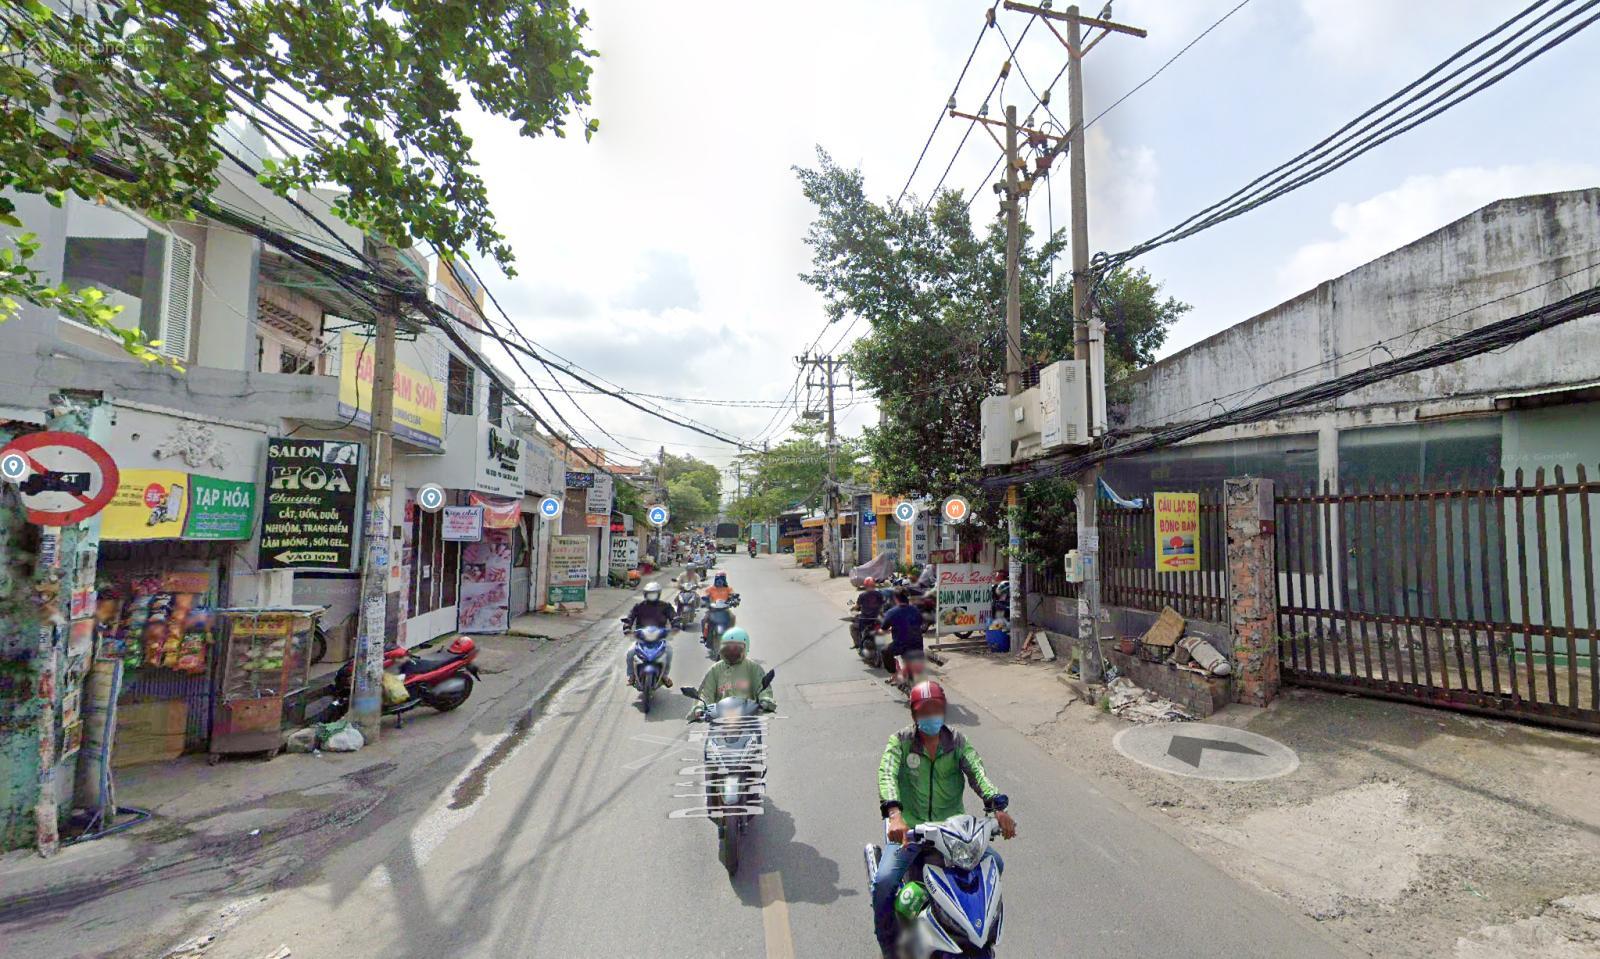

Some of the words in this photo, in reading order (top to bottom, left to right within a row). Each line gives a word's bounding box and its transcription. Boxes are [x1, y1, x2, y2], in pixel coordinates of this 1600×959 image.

[269, 445, 321, 458] SALON
[270, 466, 351, 492] HOA
[196, 487, 219, 511] TẠP
[223, 485, 250, 508] HÓA
[303, 524, 328, 533] TRANG
